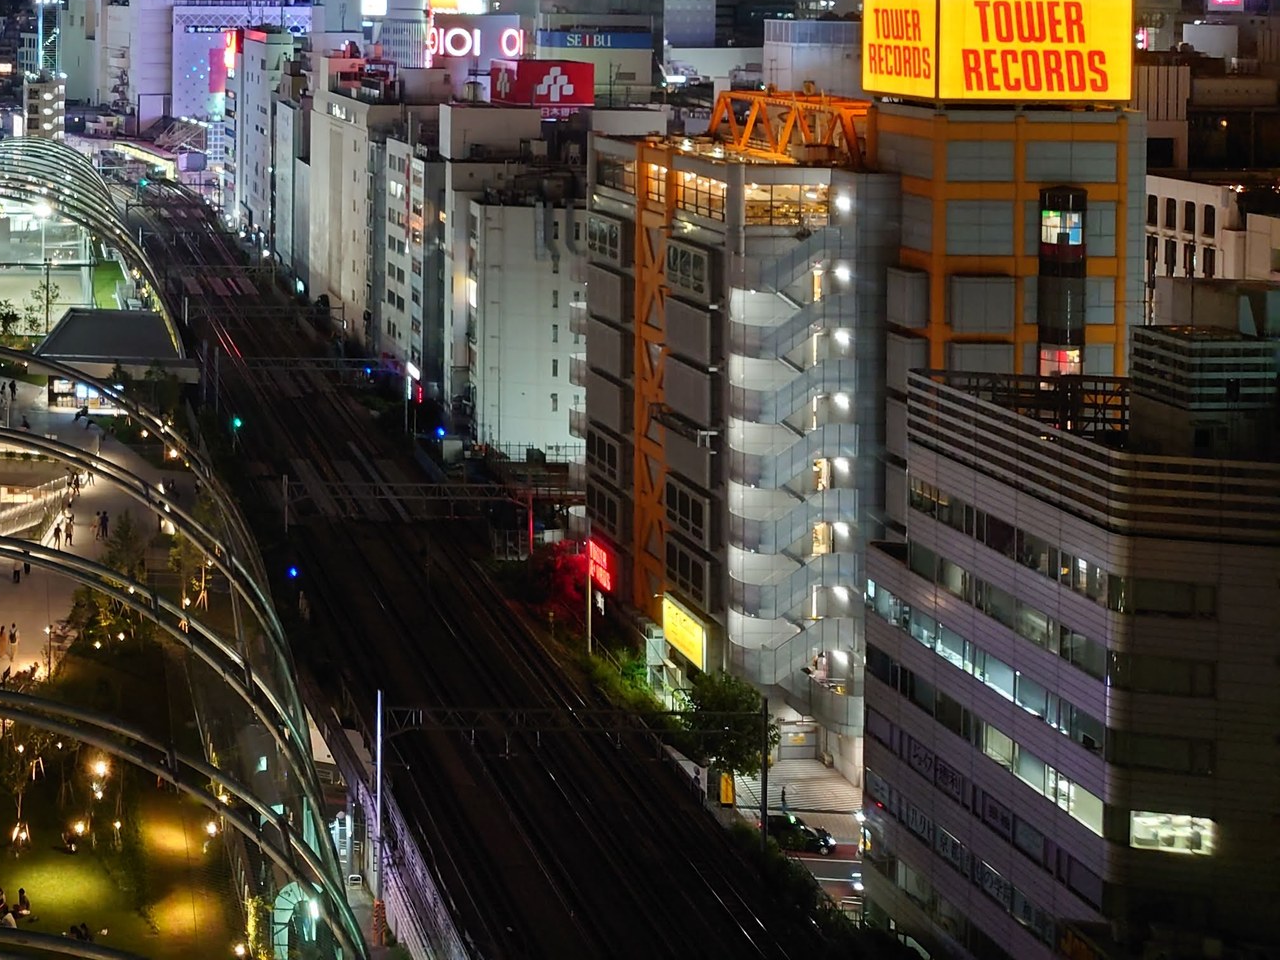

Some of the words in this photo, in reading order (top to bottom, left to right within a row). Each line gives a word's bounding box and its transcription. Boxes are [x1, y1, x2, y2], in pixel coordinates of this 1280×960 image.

[873, 8, 922, 42] TOWER
[974, 0, 1086, 44] TOWER
[868, 43, 931, 80] RECORDS
[962, 48, 1109, 93] RECORDS
